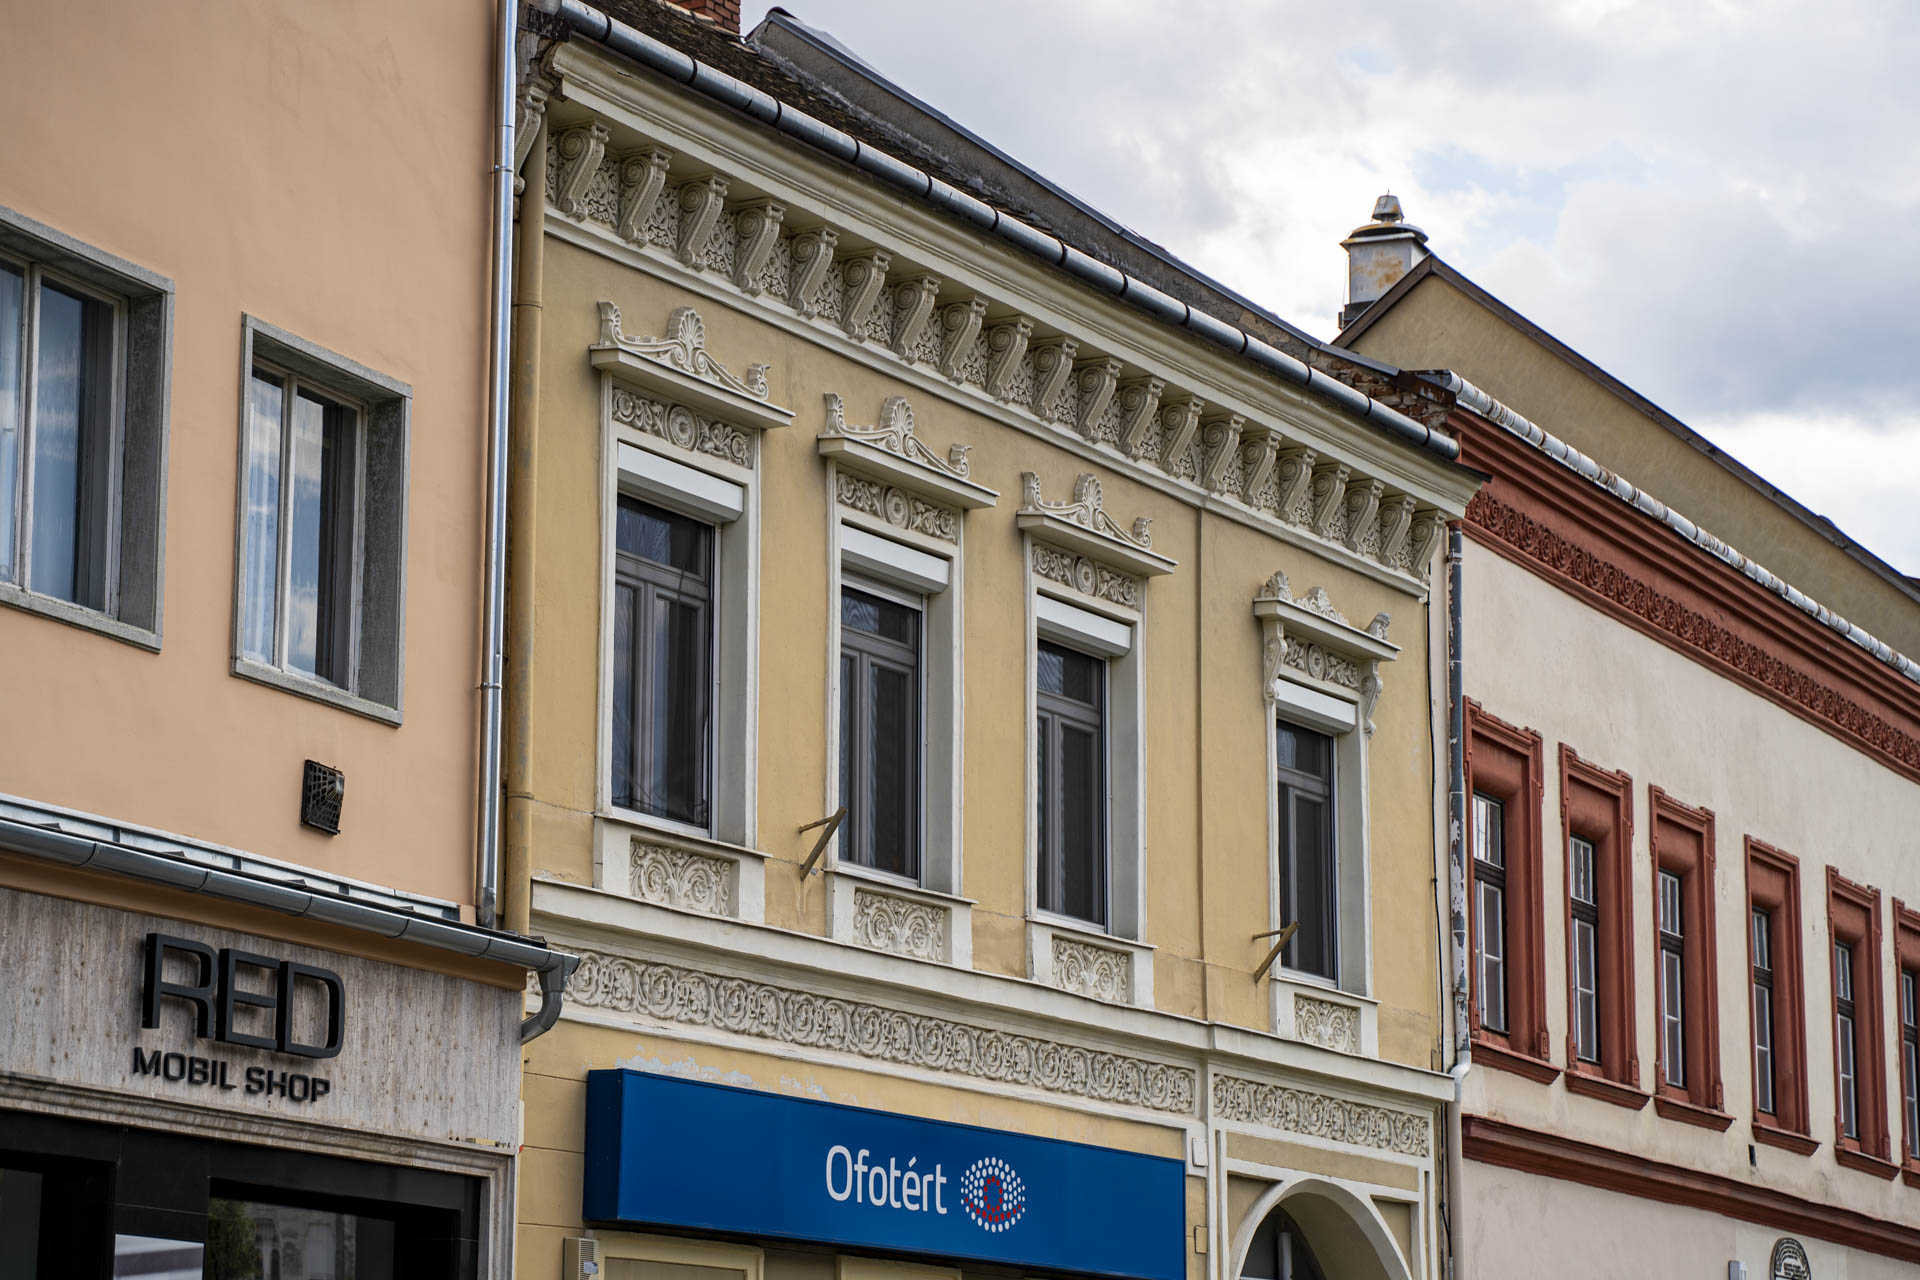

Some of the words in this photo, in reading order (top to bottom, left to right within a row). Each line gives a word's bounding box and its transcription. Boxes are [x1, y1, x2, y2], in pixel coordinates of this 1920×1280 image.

[142, 933, 346, 1058] RED
[133, 1047, 237, 1090] MOBIL
[245, 1066, 331, 1103] SHOP
[825, 1145, 948, 1215] Ofotért
